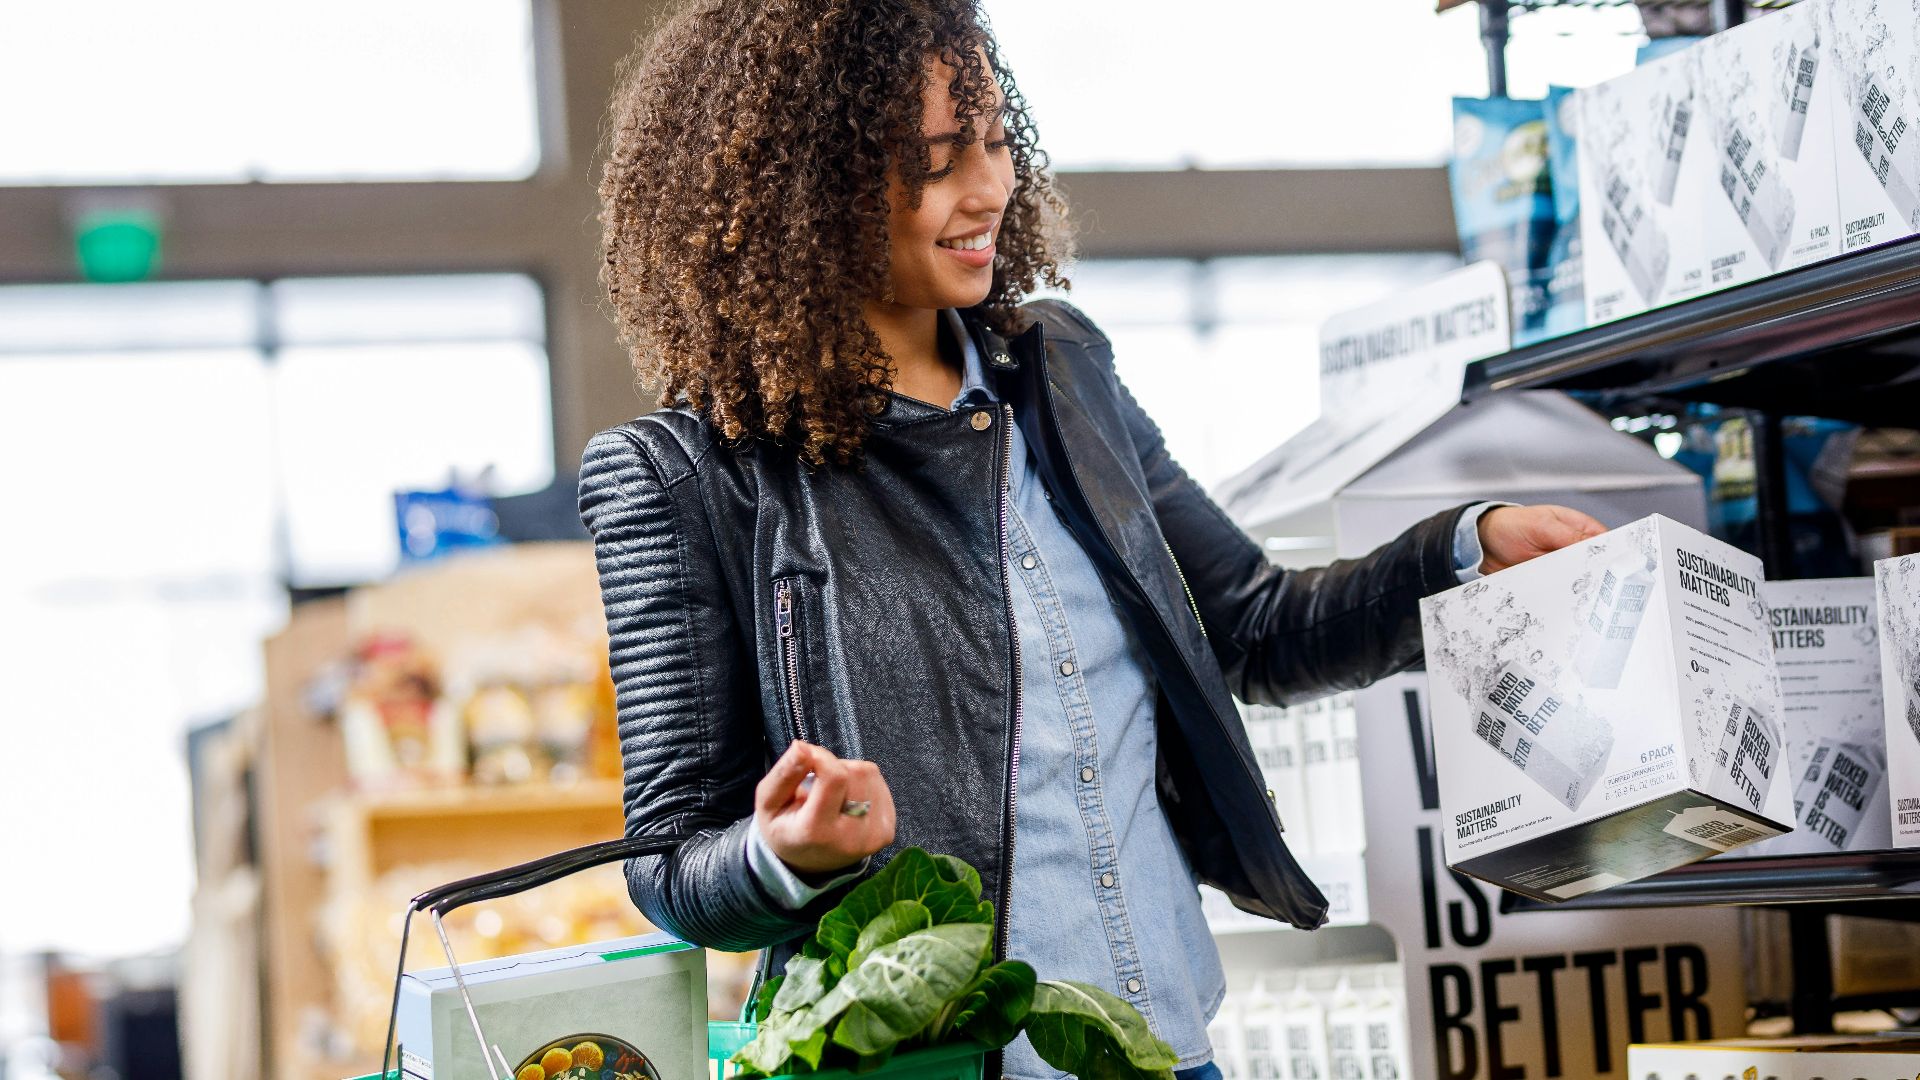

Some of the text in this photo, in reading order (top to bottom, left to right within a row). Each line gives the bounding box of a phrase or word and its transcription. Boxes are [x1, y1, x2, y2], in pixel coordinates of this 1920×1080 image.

[1862, 84, 1880, 118] BOXED
[1869, 94, 1888, 129] WATER
[1877, 125, 1888, 142] IS
[1845, 212, 1885, 235] SUSTAINABILITY
[1846, 231, 1871, 249] MATTERS
[1677, 548, 1756, 598] SUSTAINABILITY
[1680, 570, 1730, 607] MATTERS
[1770, 606, 1868, 626] STAINABILITY
[1772, 628, 1825, 648] ATTERS
[1488, 672, 1518, 706] BOXED
[1500, 681, 1533, 715] WATER
[1513, 710, 1529, 726] IS
[1640, 744, 1675, 763] 6 PACK
[1741, 730, 1767, 776] WATER
[1745, 715, 1770, 758] BOXED
[1735, 746, 1746, 767] IS
[1832, 752, 1869, 788] BOXED
[1730, 761, 1761, 812] BETTER.
[1814, 789, 1830, 810] IS
[1824, 770, 1862, 809] WATER
[1456, 794, 1521, 827] SUSTAINABILITY
[1457, 816, 1497, 839] MATTERS
[1429, 944, 1712, 1080] BETTER
